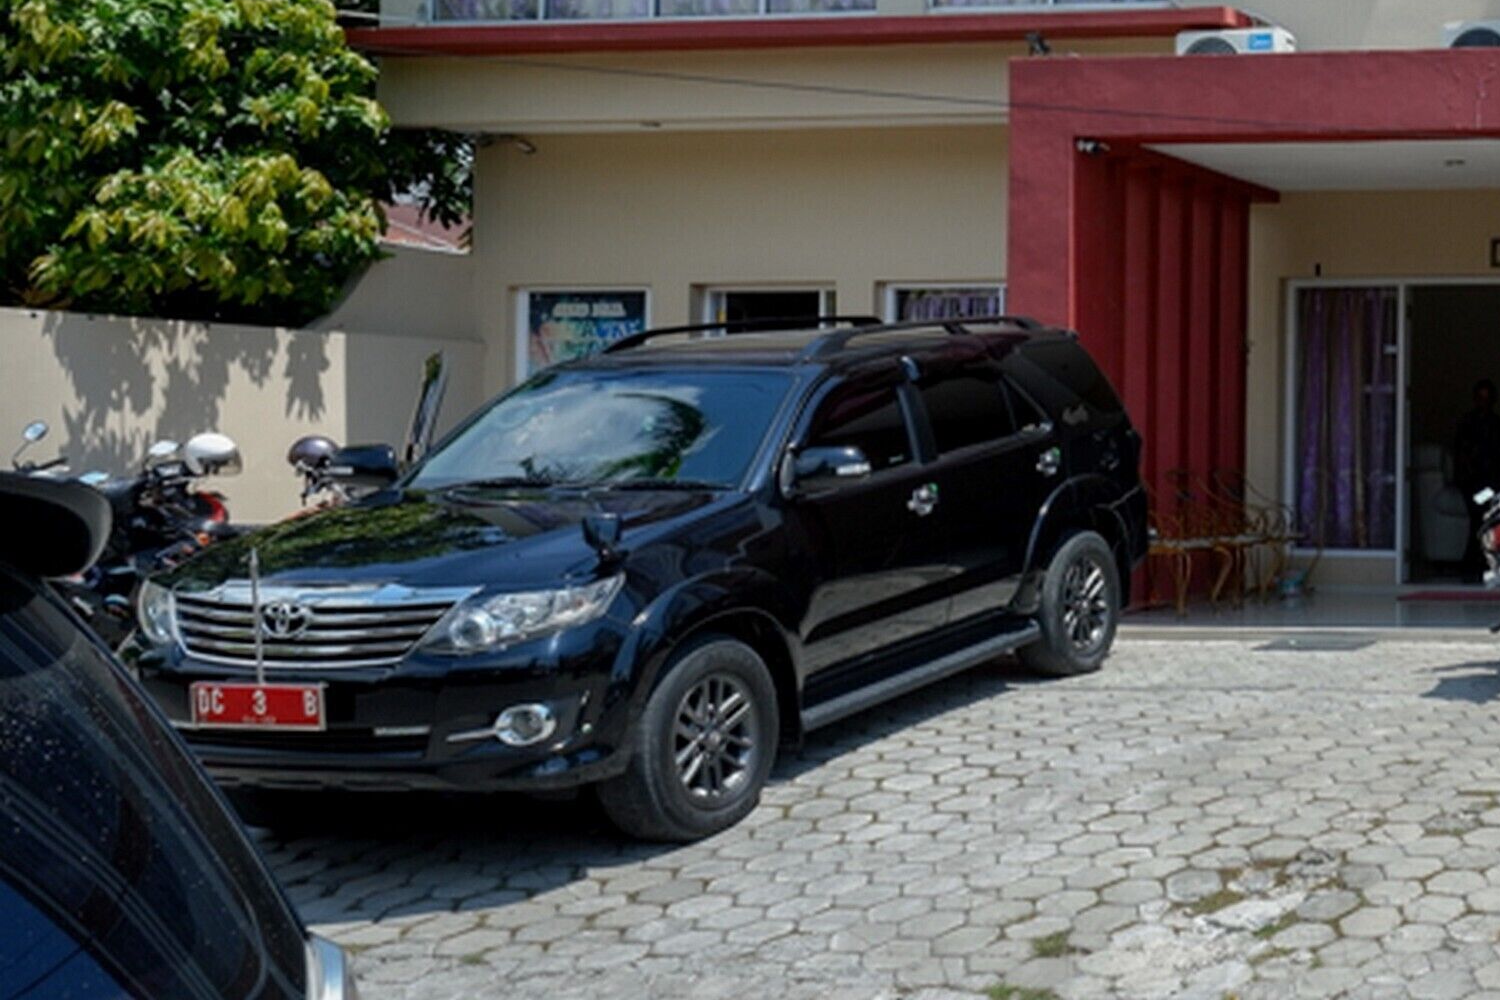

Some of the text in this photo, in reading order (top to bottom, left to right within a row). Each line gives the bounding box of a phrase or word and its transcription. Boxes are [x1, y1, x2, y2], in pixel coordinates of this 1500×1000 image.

[198, 687, 318, 717] DC 3 B
